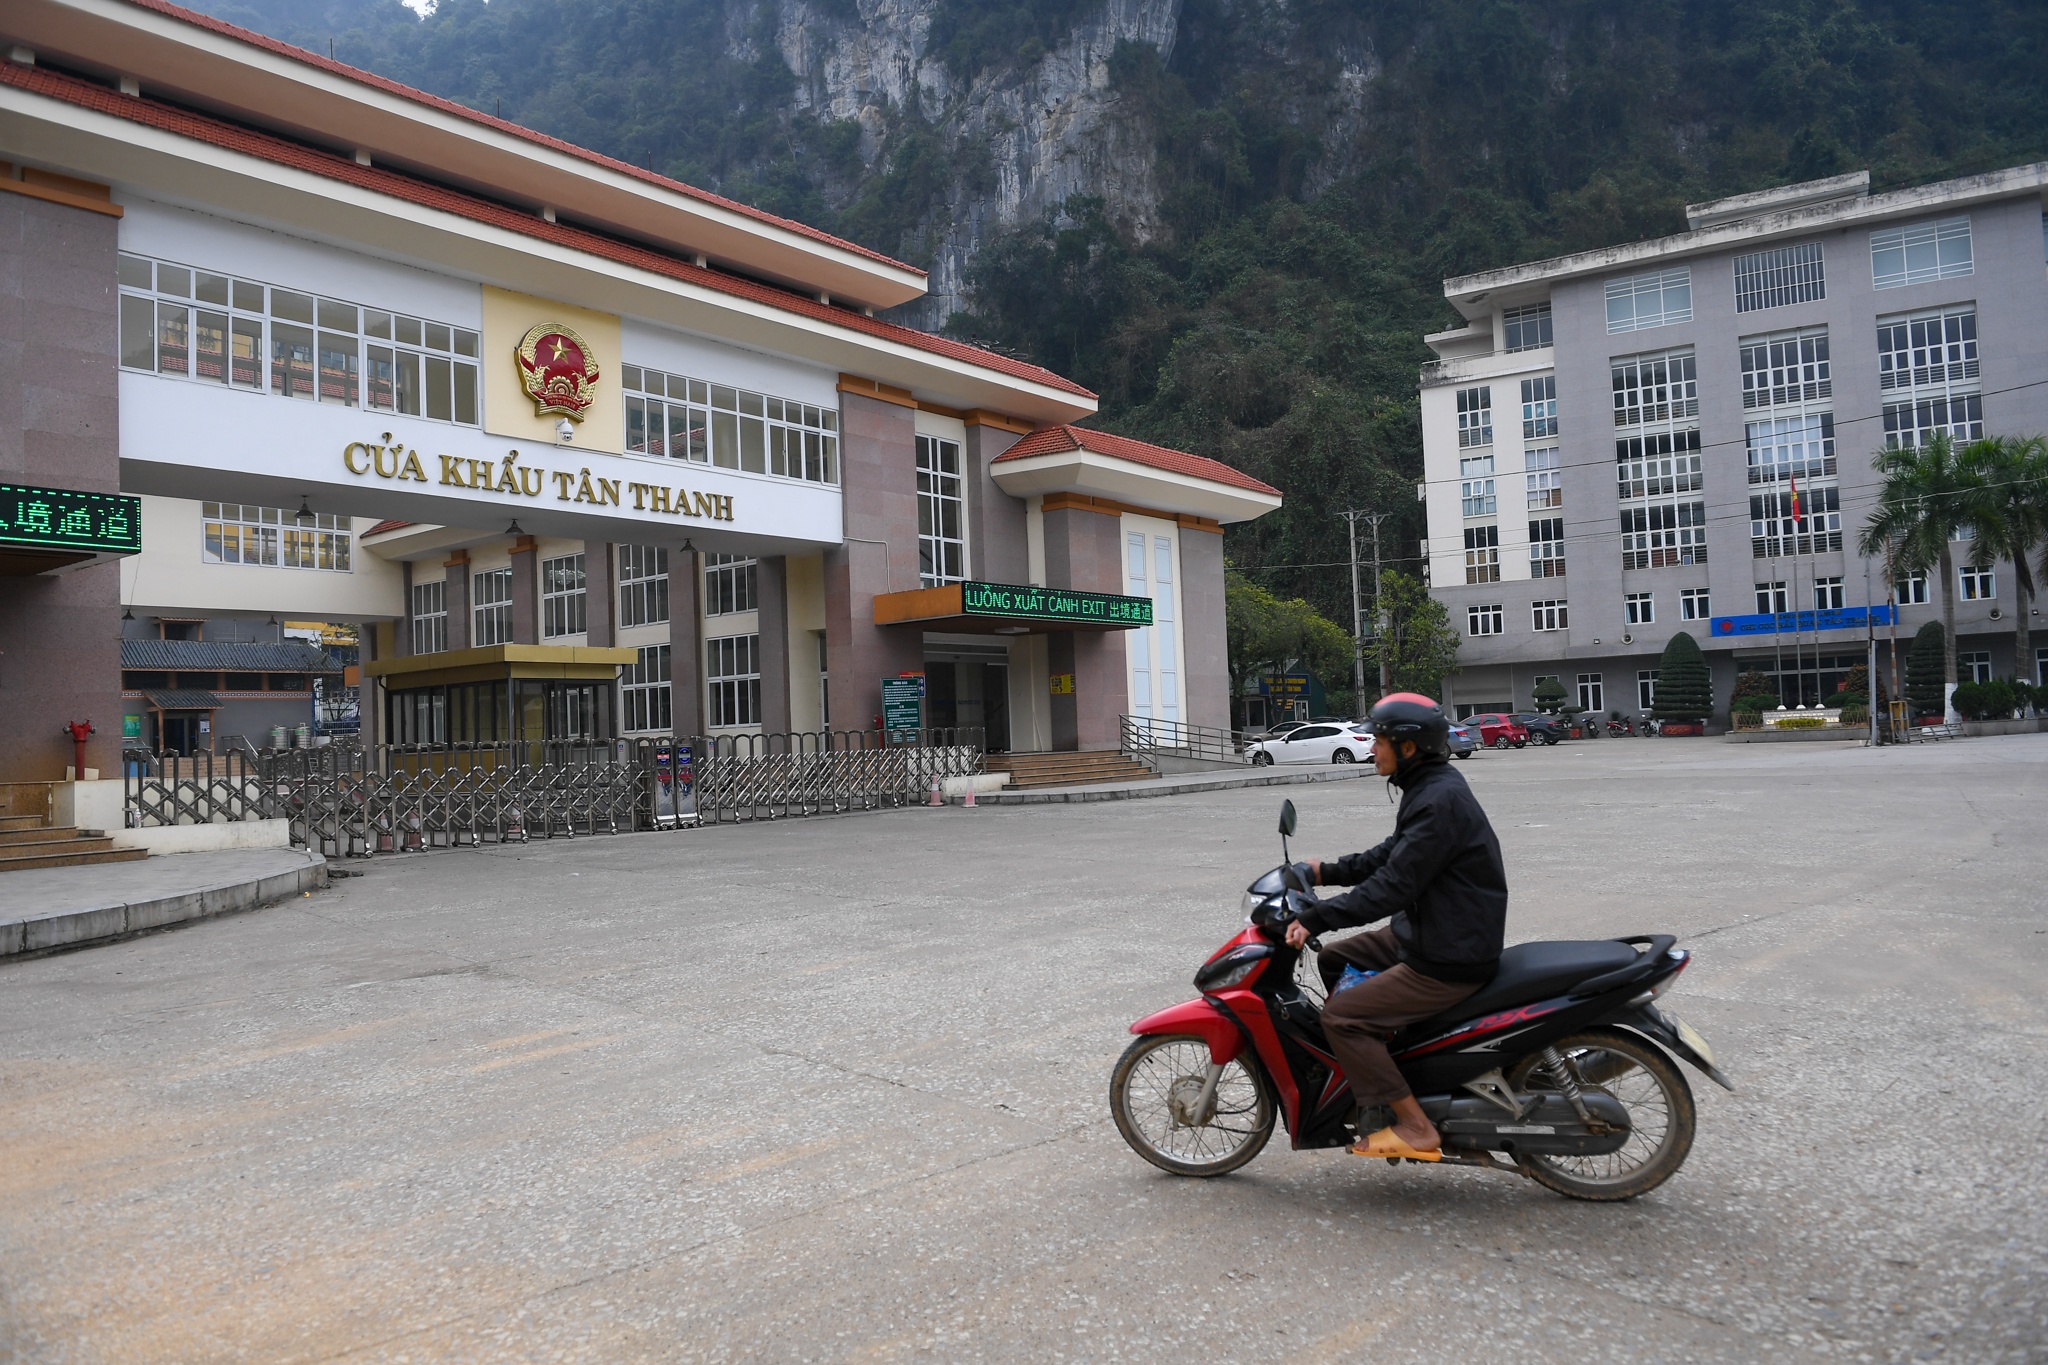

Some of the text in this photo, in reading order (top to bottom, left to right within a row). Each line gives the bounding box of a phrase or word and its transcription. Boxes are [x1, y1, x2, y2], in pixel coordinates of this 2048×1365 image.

[344, 431, 735, 522] CỬA KHẨU TÂN THANH
[1082, 599, 1107, 616] EXIT
[1109, 601, 1152, 621] 出境通道
